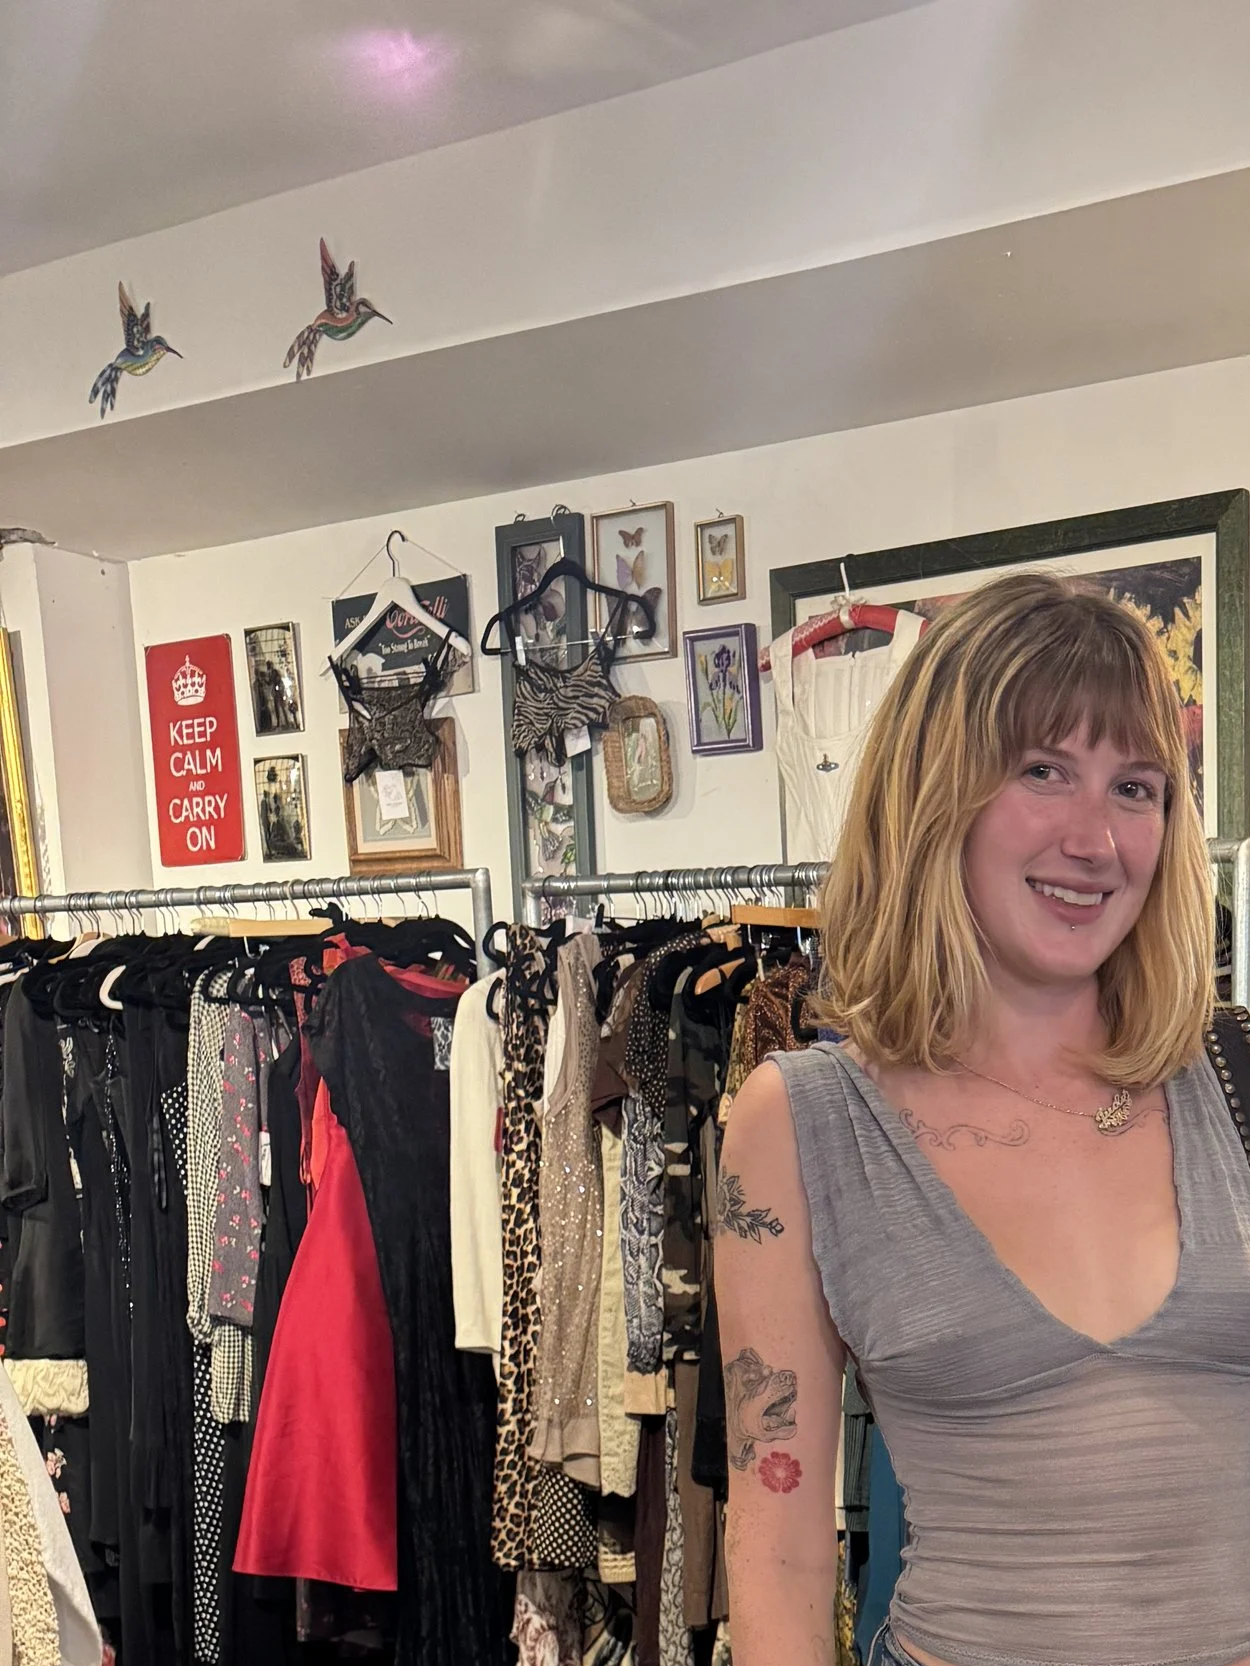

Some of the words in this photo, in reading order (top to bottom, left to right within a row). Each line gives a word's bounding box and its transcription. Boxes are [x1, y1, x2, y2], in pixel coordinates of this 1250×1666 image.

[169, 716, 217, 747] KEEP
[169, 747, 223, 777] CALM
[188, 780, 206, 792] AND
[169, 793, 228, 824] CARRY
[186, 825, 216, 852] ON
